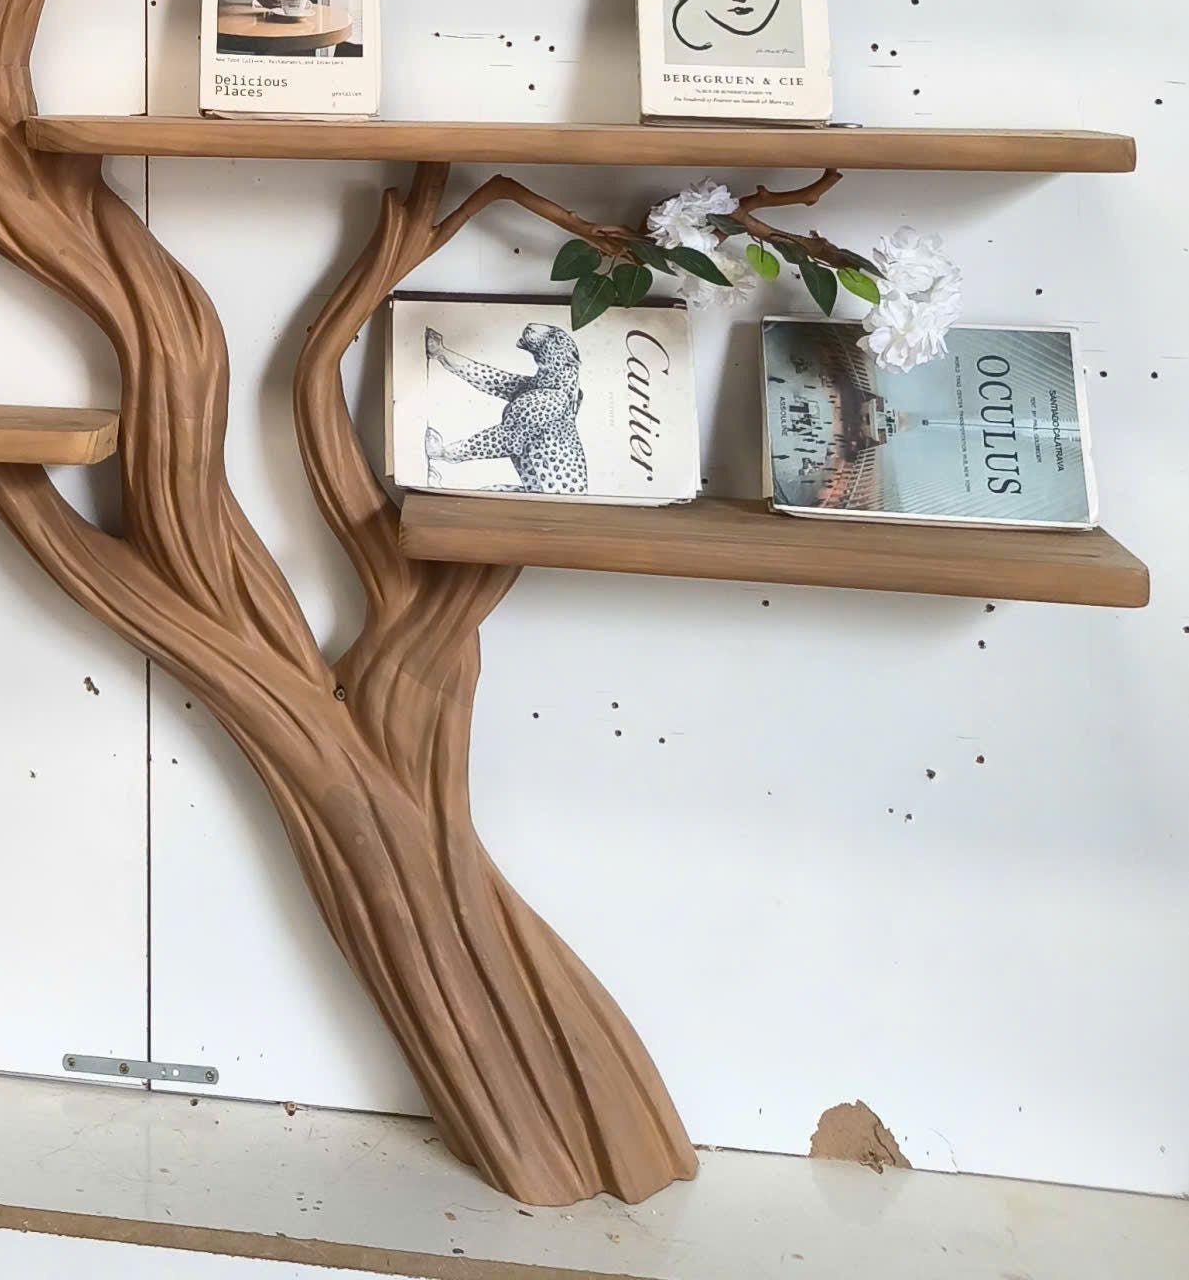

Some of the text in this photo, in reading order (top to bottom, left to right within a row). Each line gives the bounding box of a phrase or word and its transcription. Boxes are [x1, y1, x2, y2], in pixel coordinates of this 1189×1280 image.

[215, 74, 288, 88] Delicious
[215, 85, 263, 98] Places
[663, 74, 804, 86] BERGGRUEN & CIE
[624, 329, 671, 482] Cartier
[976, 355, 1022, 496] OCULUS
[1048, 389, 1065, 472] SANTIAGO CALATRAVA
